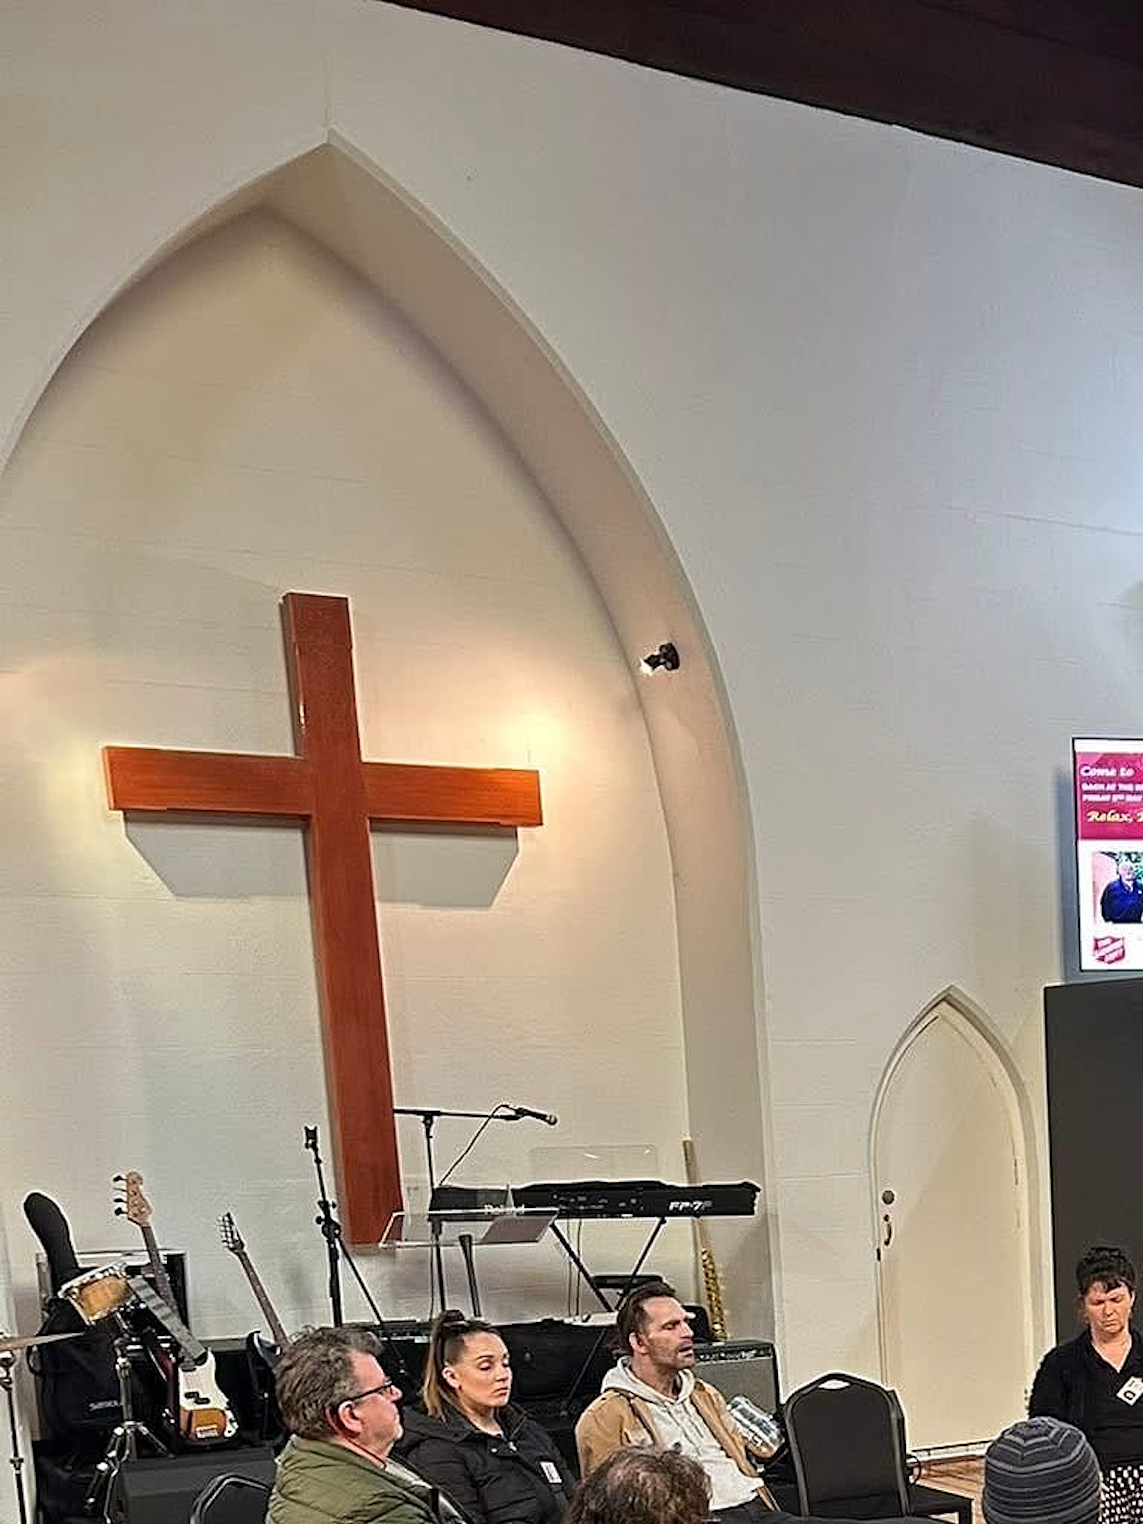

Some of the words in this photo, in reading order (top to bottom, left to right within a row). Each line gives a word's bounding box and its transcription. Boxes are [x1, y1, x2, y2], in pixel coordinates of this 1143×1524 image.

[1080, 765, 1117, 777] Come
[1119, 767, 1135, 777] to
[1087, 808, 1133, 823] Relax,
